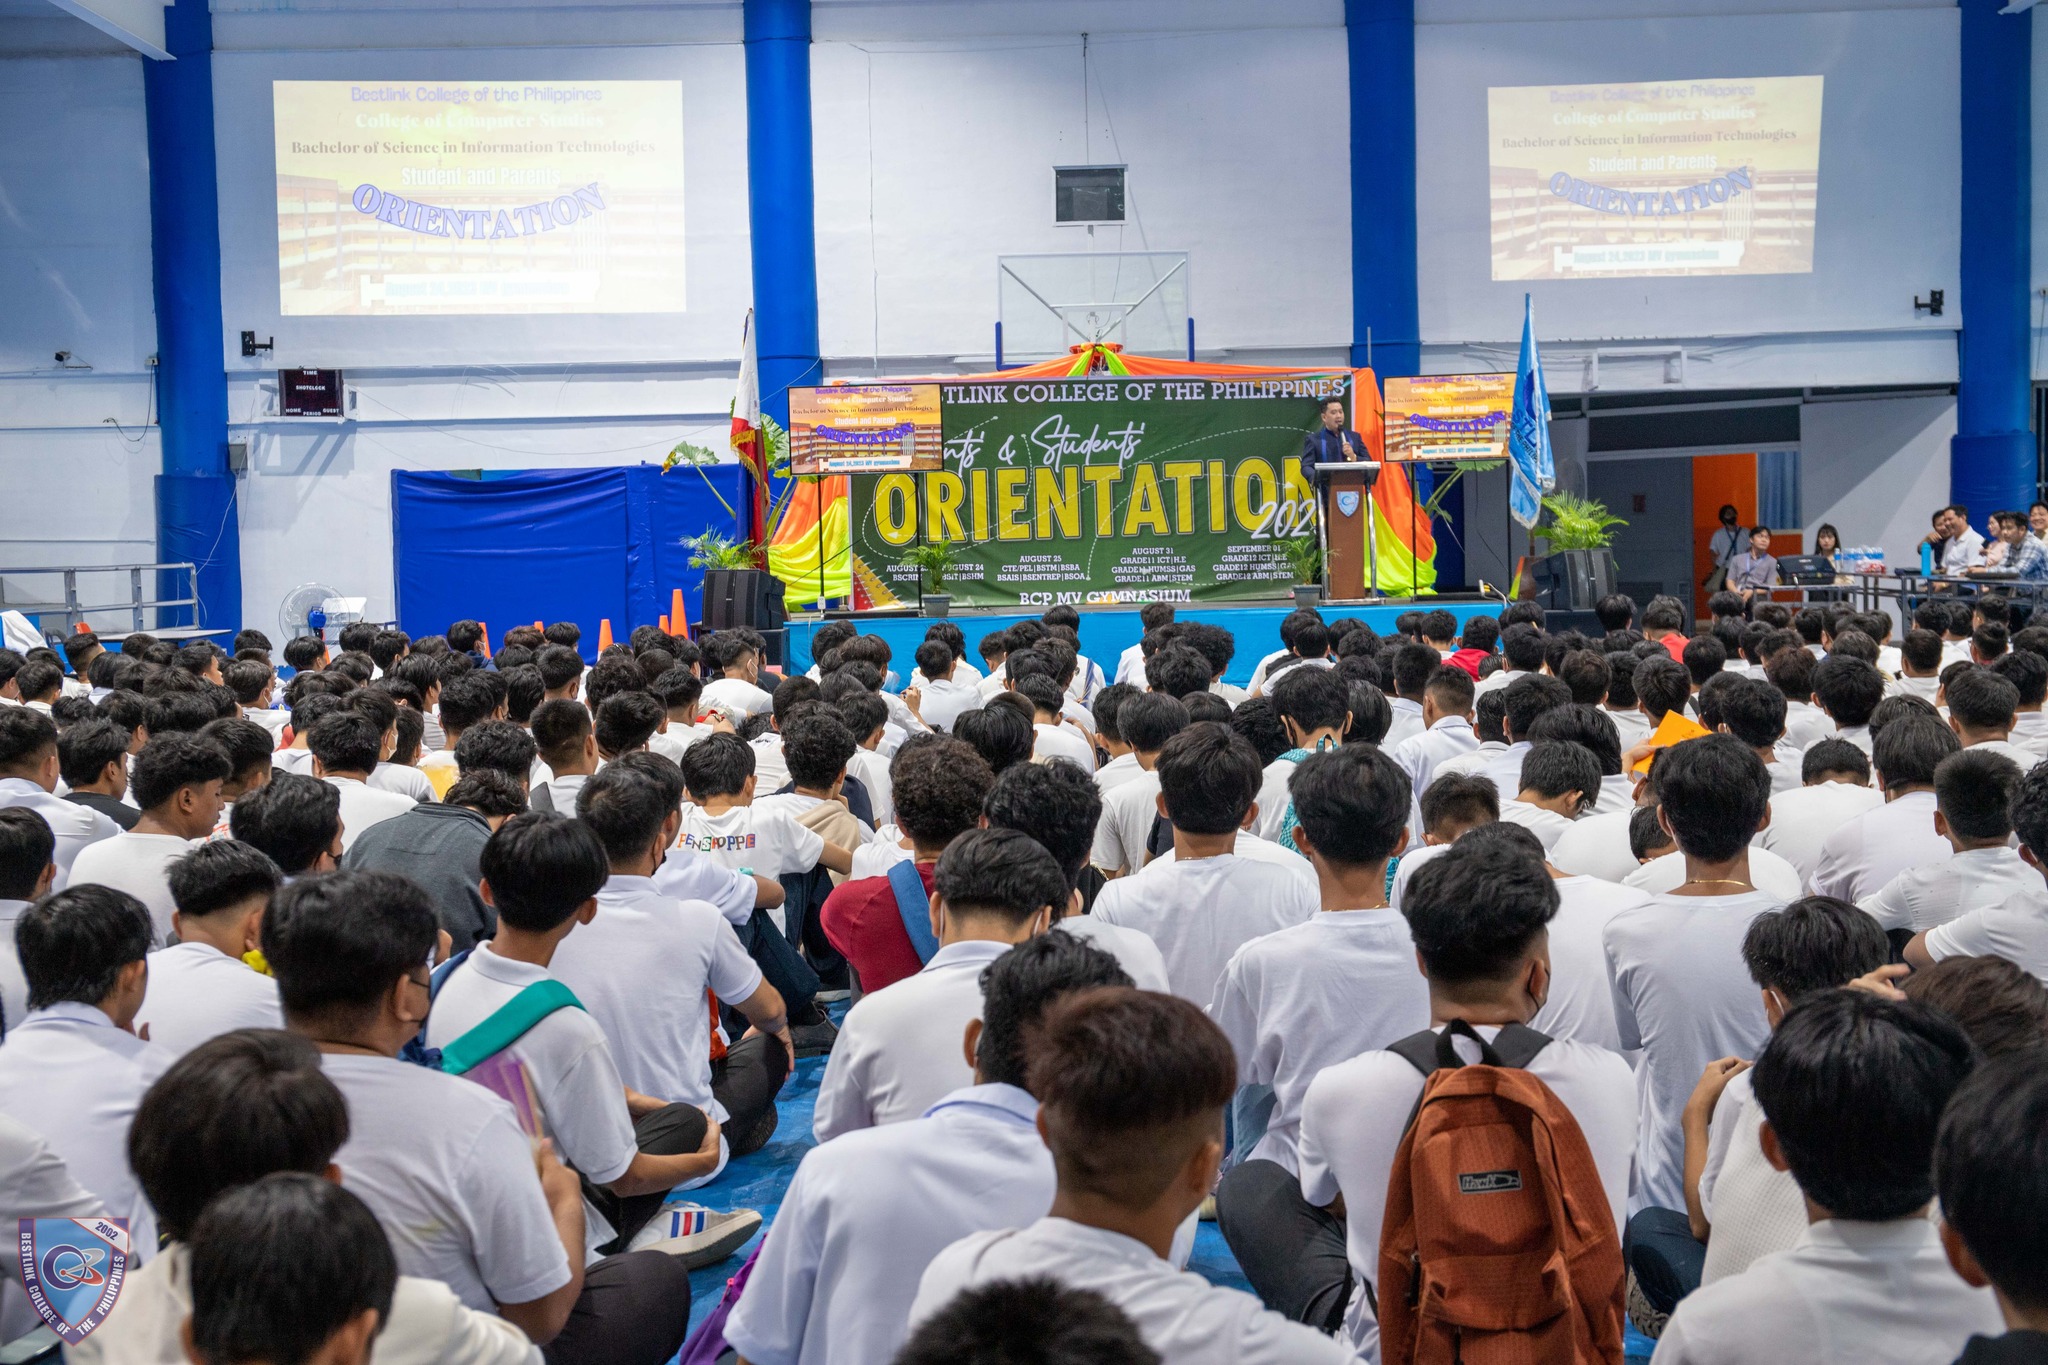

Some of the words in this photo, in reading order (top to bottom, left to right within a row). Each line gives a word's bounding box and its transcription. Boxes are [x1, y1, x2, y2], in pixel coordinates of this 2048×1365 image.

[351, 86, 411, 101] Bestlink
[416, 86, 470, 105] College
[473, 86, 490, 102] of
[493, 86, 520, 102] the
[523, 85, 602, 104] Philippines
[355, 112, 420, 132] College
[424, 112, 443, 128] of
[446, 112, 536, 132] Computer
[539, 112, 605, 128] Studies
[1552, 111, 1606, 128] College
[1607, 110, 1623, 123] of
[1625, 108, 1699, 125] Computer
[1701, 105, 1758, 121] Studies
[291, 140, 360, 154] Bachelor
[363, 140, 380, 154] of
[383, 140, 439, 154] Science
[442, 140, 458, 154] in
[461, 139, 553, 153] Information
[557, 139, 656, 156] Technologies
[1502, 136, 1557, 149] Bachelor
[1558, 136, 1573, 147] of
[1574, 134, 1620, 147] Science
[1622, 133, 1635, 145] in
[1637, 131, 1713, 145] Information
[1715, 128, 1798, 143] Technologies
[1588, 155, 1637, 174] Student
[1641, 155, 1665, 172] and
[1667, 153, 1718, 171] Parents
[402, 167, 462, 186] Student
[467, 167, 496, 186] and
[500, 166, 561, 186] Parents
[1548, 165, 1753, 217] ORIENTATION
[351, 181, 607, 240] ORIENTATION
[942, 385, 1008, 404] TLINK
[1013, 383, 1118, 403] COLLEGE
[1124, 382, 1156, 402] OF
[1161, 382, 1206, 401] THE
[1211, 378, 1345, 400] PHILIPPINES
[1409, 410, 1506, 433] ORIENTATION
[1511, 407, 1538, 448] STL
[815, 421, 915, 445] ORIENTATION
[943, 428, 985, 478] nts'
[997, 434, 1016, 466] &
[1030, 414, 1146, 473] Students'
[873, 456, 1316, 547] ORIENTATION
[1250, 498, 1316, 540] 202
[1019, 555, 1052, 563] AUGUST
[1132, 547, 1165, 555] AUGUST
[1165, 547, 1174, 555] 31
[1221, 554, 1257, 562] GRADE12
[1227, 545, 1272, 553] SEPTEMBER
[886, 564, 919, 572] AUGUST
[975, 563, 984, 571] 24
[1120, 556, 1155, 565] GRADE11
[1212, 563, 1248, 572] GRADE12
[1114, 575, 1150, 583] GRADE11
[1215, 572, 1252, 580] GRADE12
[1019, 592, 1053, 606] BCP
[1056, 591, 1083, 606] MV
[1086, 589, 1191, 604] GYMNASIUM
